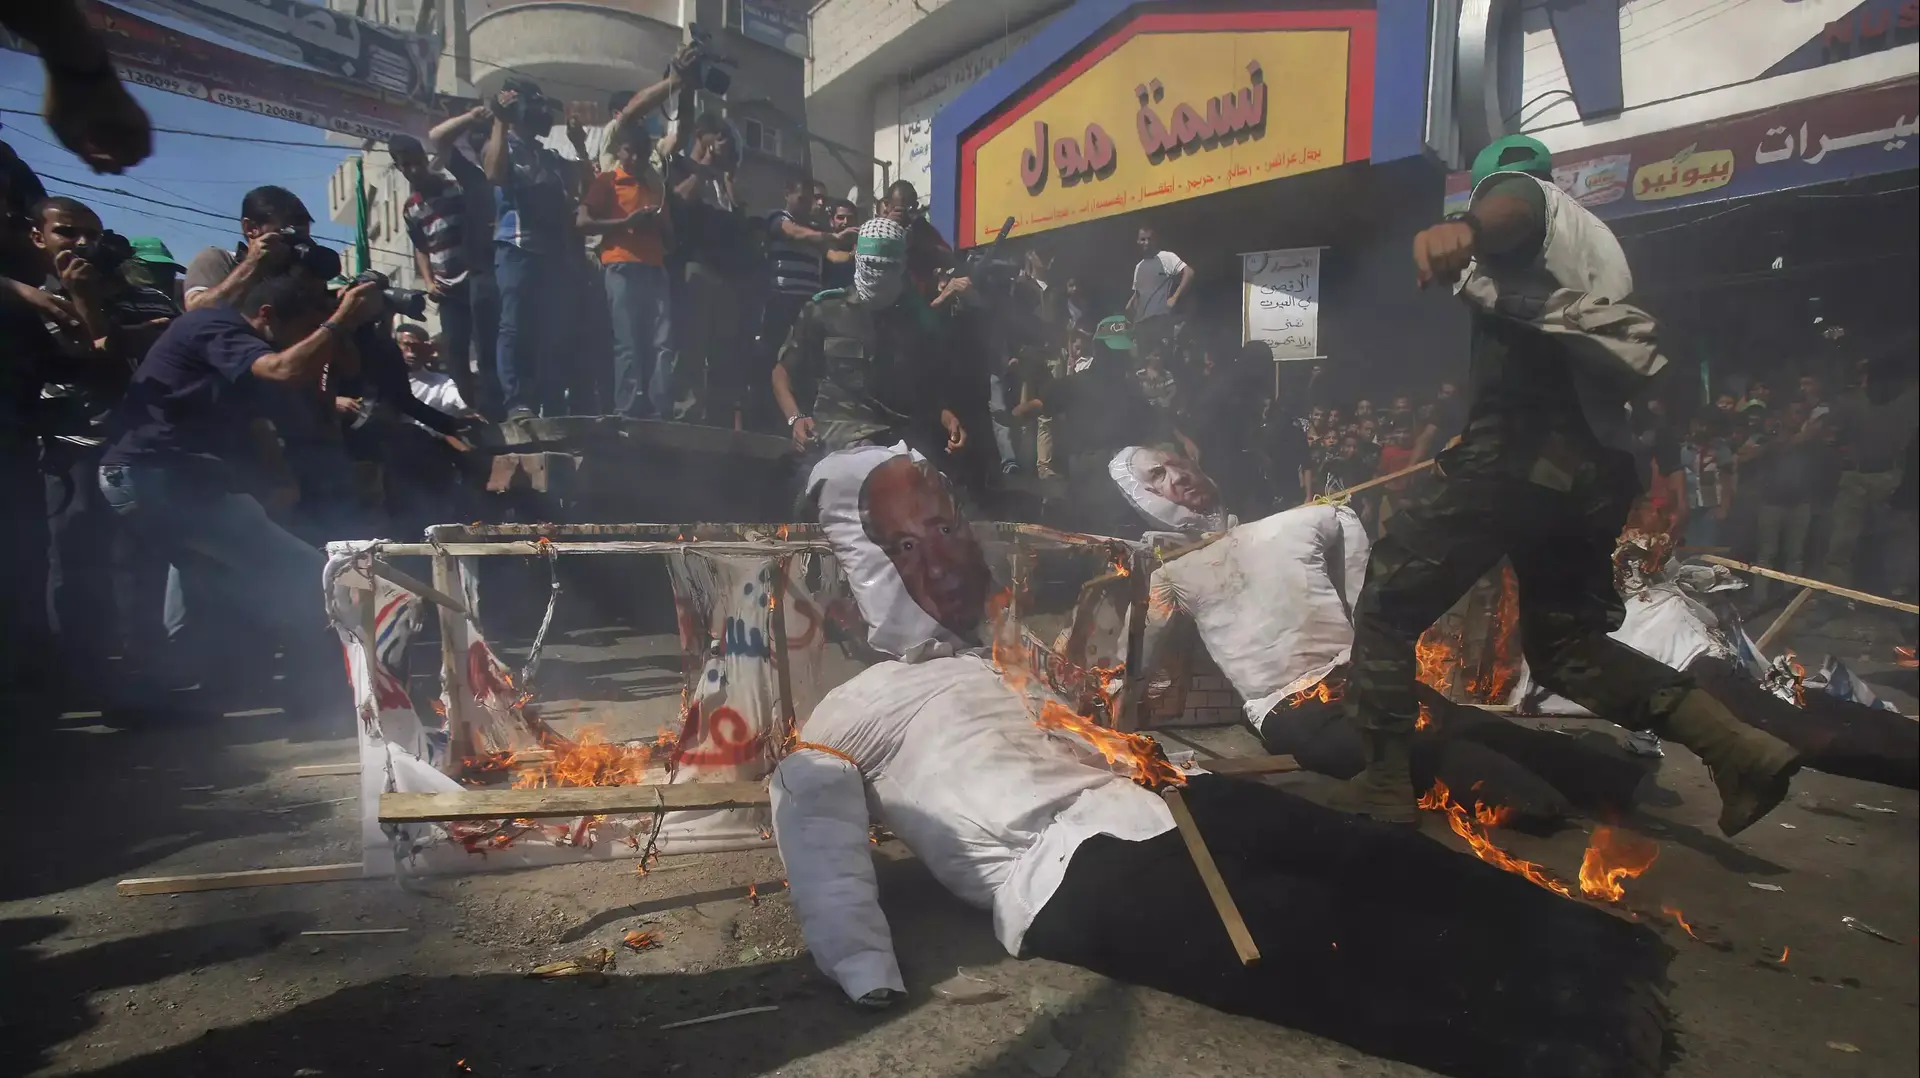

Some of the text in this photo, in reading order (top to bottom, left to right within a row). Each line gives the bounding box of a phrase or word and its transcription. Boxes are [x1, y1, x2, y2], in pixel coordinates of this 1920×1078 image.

[119, 68, 180, 90] -120099
[1020, 60, 1267, 196] نسمة مول
[1755, 115, 1918, 165] يرات
[1186, 175, 1214, 192] حريمي
[1226, 163, 1252, 184] رجالي
[1636, 159, 1731, 195] بيونير
